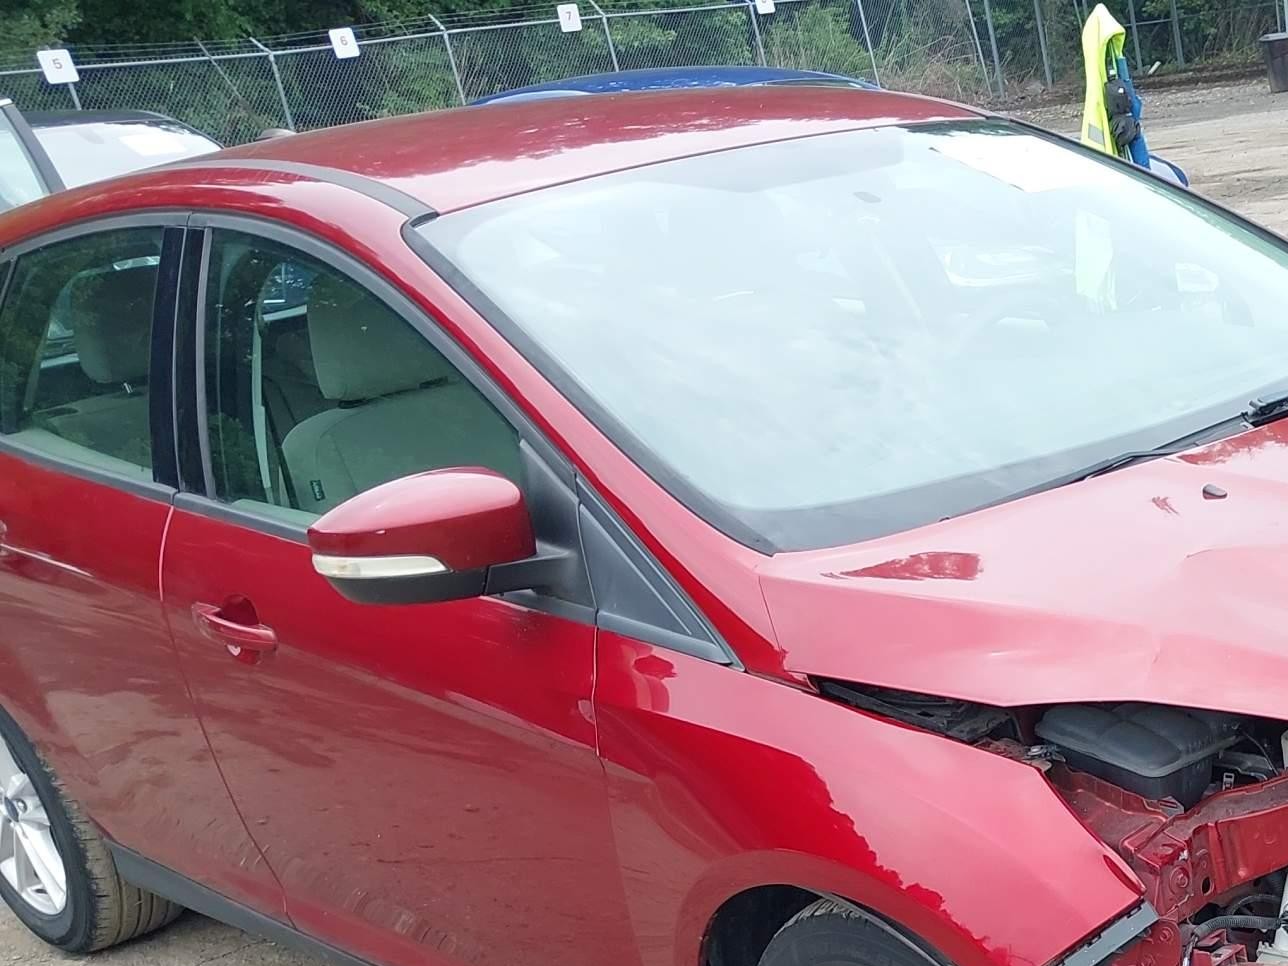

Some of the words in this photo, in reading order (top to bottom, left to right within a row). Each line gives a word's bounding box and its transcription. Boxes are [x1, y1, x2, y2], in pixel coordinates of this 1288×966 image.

[565, 11, 572, 20] 7
[340, 35, 348, 46] 6
[52, 58, 63, 69] 5
